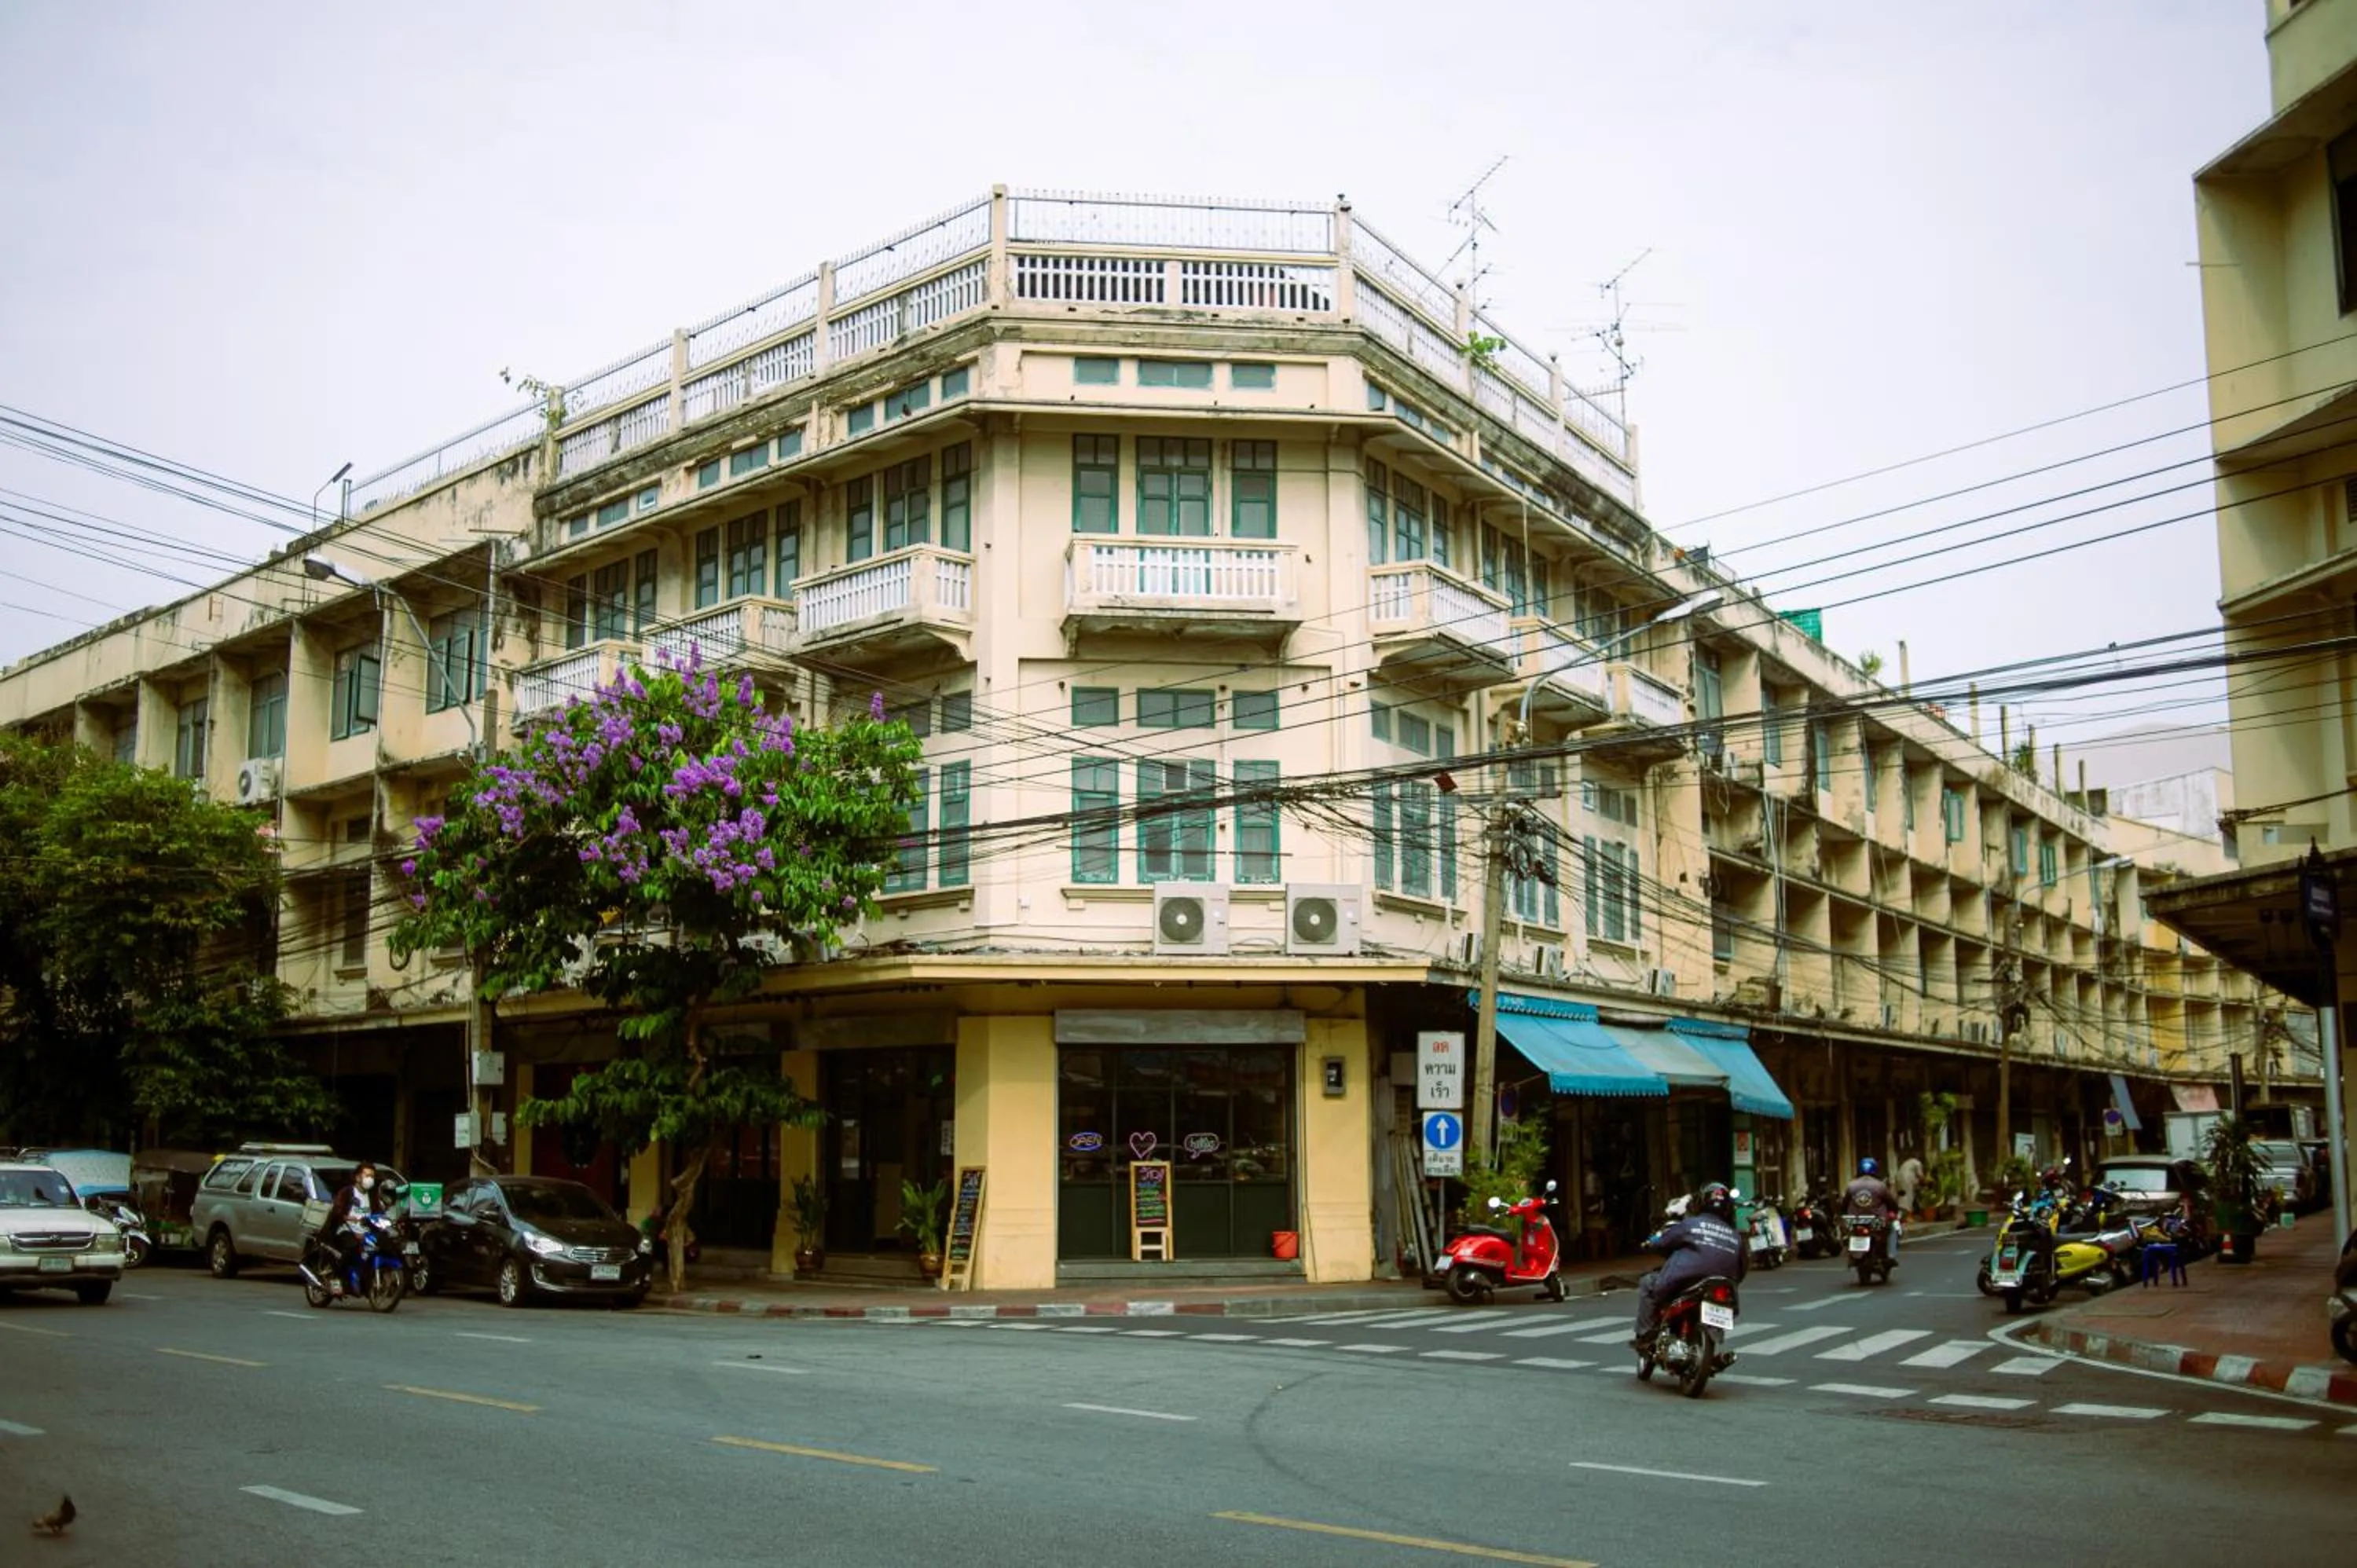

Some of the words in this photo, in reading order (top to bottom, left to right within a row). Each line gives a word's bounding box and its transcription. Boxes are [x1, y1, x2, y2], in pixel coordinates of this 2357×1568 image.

[1424, 1064, 1456, 1075] ความ
[1431, 1081, 1450, 1098] เร็ว
[1069, 1135, 1102, 1148] OPEN
